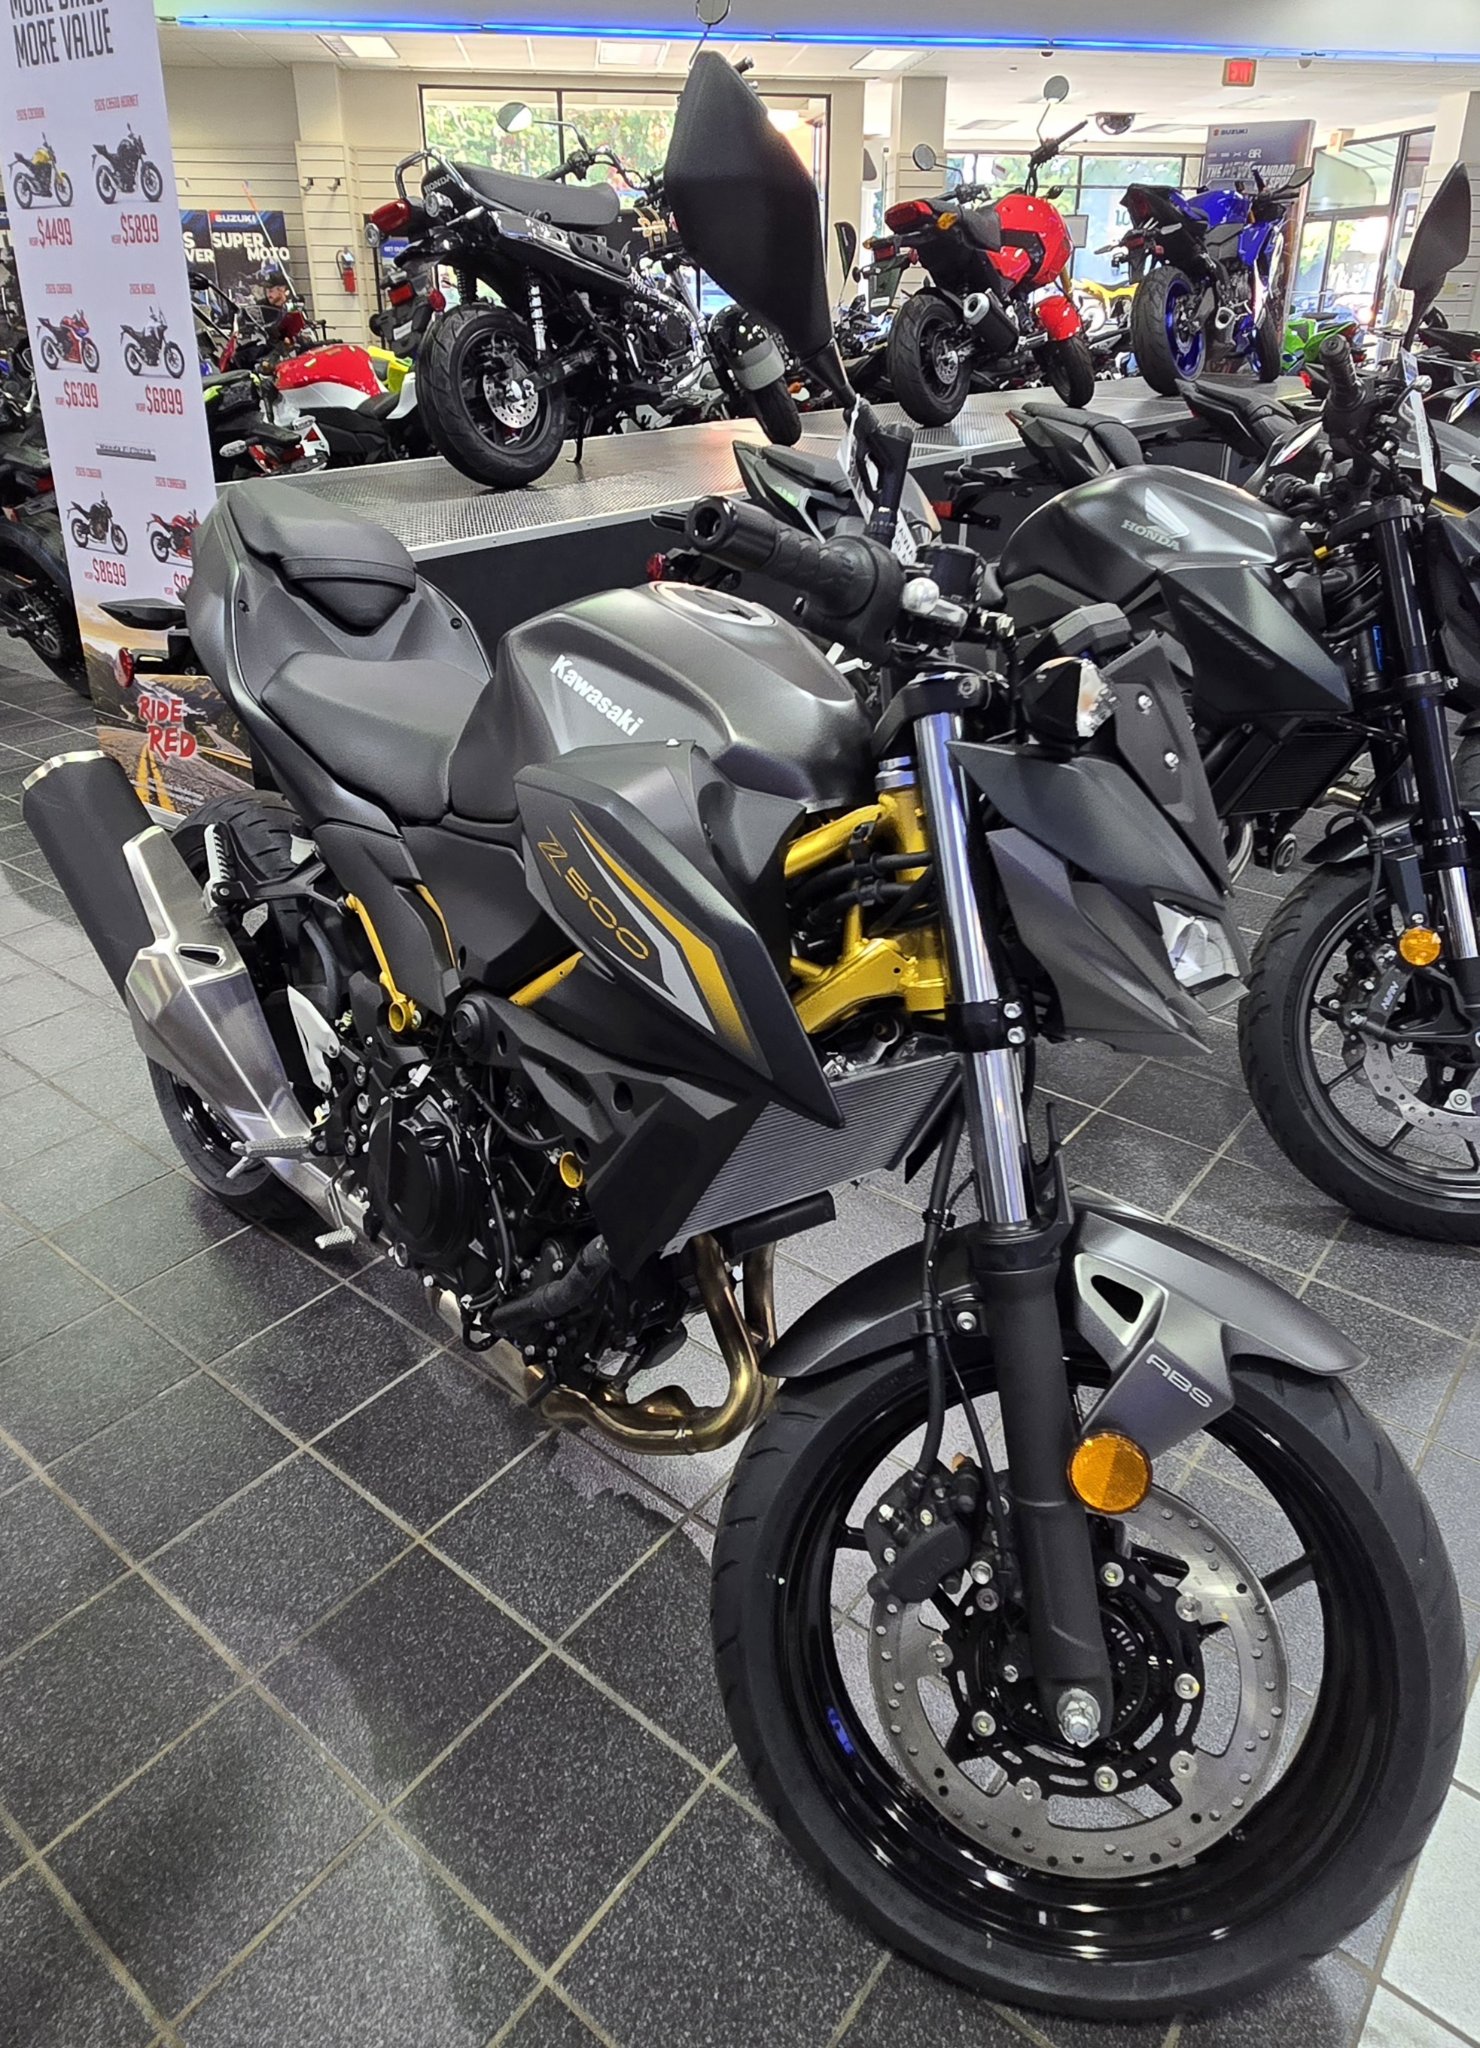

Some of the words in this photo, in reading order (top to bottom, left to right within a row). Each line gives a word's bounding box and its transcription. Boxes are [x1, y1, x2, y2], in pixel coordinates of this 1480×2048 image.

[13, 18, 59, 68] MORE
[59, 8, 114, 60] VALUE
[423, 174, 456, 193] HONDA
[37, 216, 73, 249] $4499
[120, 212, 159, 246] $5899
[214, 214, 257, 224] SUZUKI
[211, 231, 264, 249] SUPER
[246, 246, 290, 262] MOTO
[63, 379, 99, 409] $6399
[145, 384, 183, 415] $6899
[1120, 519, 1181, 551] HONDA
[92, 558, 127, 587] $8699
[137, 695, 184, 723] RIDE
[550, 654, 644, 737] Kawasaki
[147, 725, 197, 761] RED
[1146, 1353, 1214, 1409] ABS
